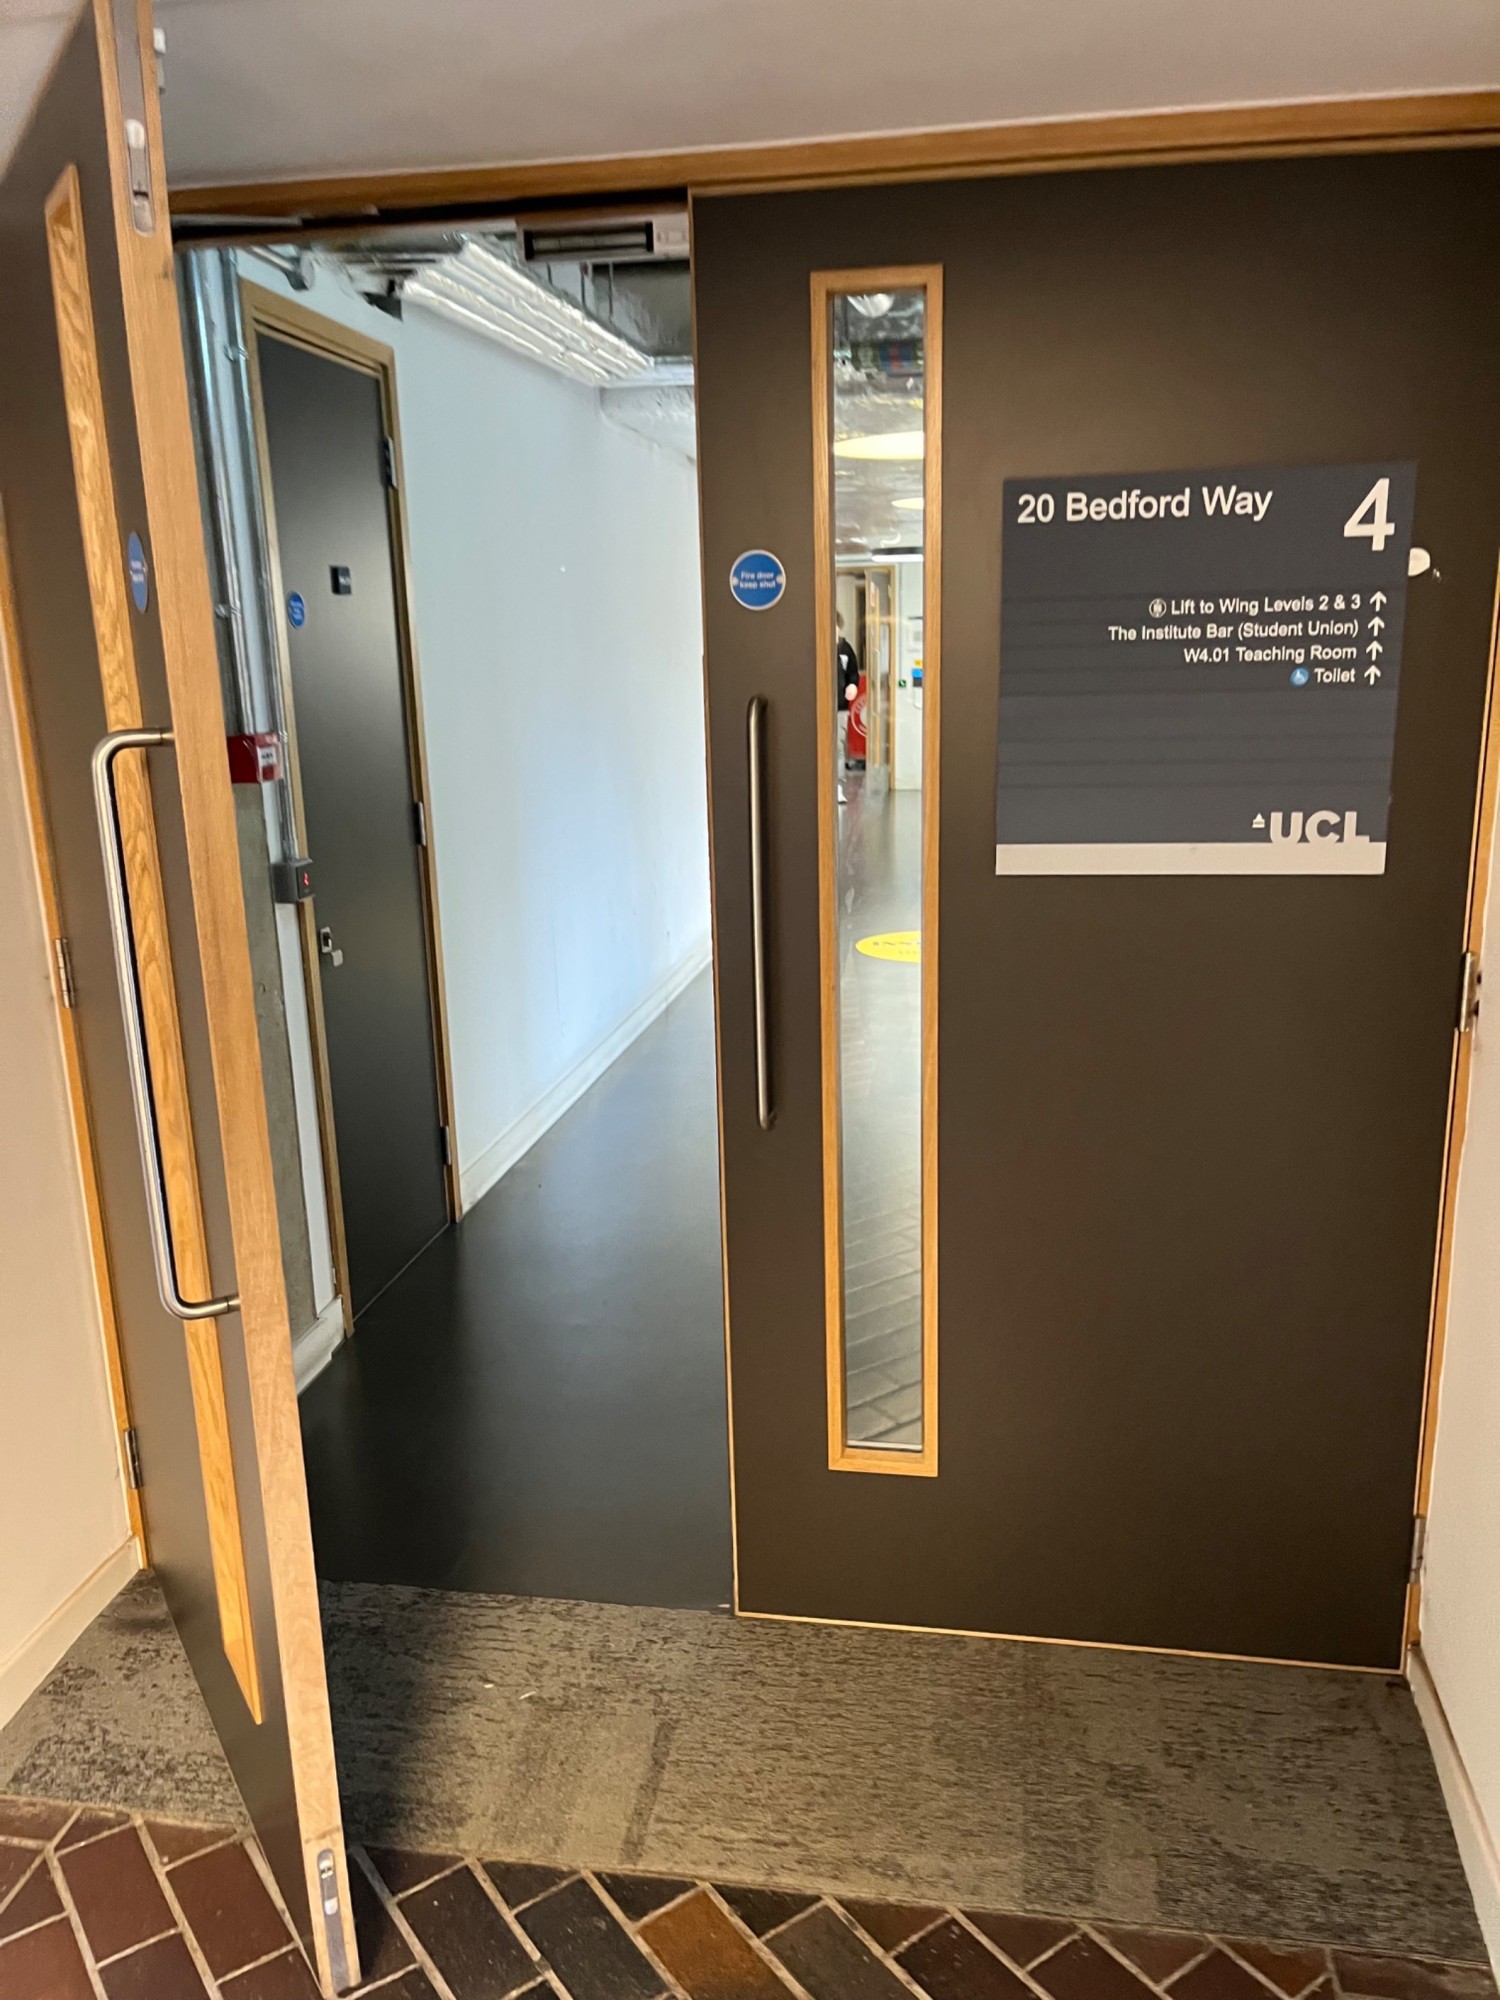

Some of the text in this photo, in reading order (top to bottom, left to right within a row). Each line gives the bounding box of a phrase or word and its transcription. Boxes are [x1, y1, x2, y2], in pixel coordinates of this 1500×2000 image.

[1017, 484, 1273, 524] 20 Bedford Way
[1343, 477, 1396, 552] 4
[739, 580, 776, 590] keep shut
[740, 571, 774, 580] Fire door
[1171, 593, 1361, 617] Lift to Wing Levels 2 & 3
[1107, 618, 1359, 641] The Institute Bar (Student Union)
[1183, 644, 1357, 665] W4.01 Teaching Room
[1313, 667, 1356, 684] Toilet
[1267, 810, 1370, 844] UCL
